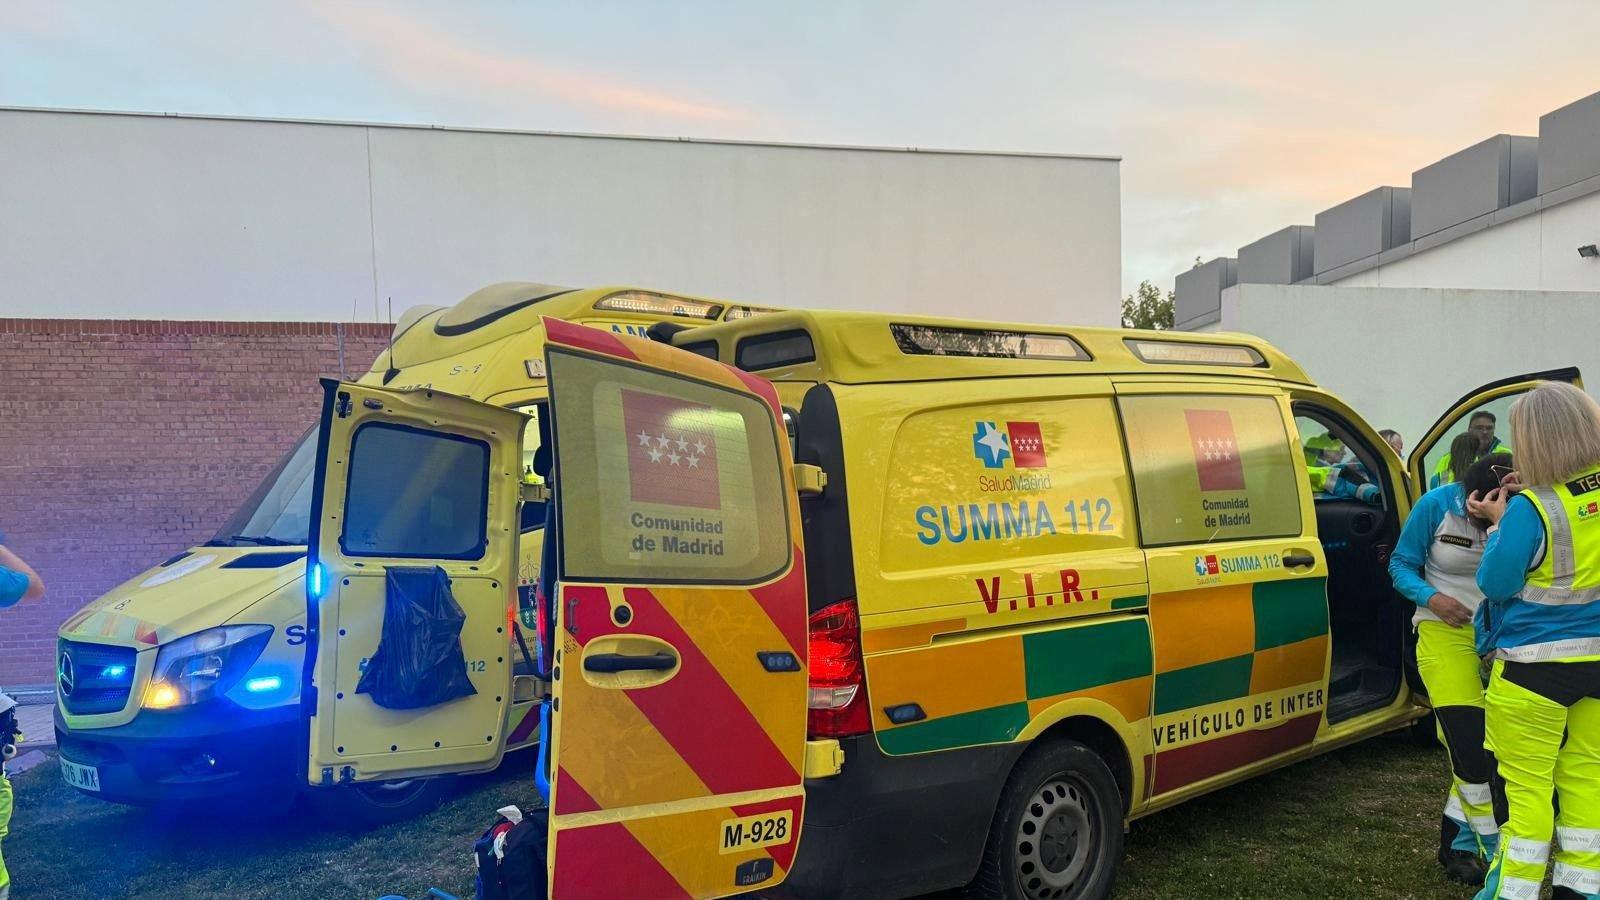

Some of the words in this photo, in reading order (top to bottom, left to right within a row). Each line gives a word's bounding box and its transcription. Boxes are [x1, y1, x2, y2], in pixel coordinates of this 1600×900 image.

[979, 475, 1052, 492] SaludMadrid
[1202, 498, 1249, 511] Comunidad
[631, 512, 723, 534] Comunidad
[915, 500, 1057, 545] SUMMA
[1064, 497, 1114, 534] 112
[1204, 515, 1217, 528] de
[1219, 513, 1251, 527] Madrid
[631, 534, 656, 552] de
[662, 535, 724, 556] Madrid
[1220, 555, 1262, 574] SUMMA
[1263, 553, 1280, 569] 112
[975, 568, 1099, 614] V.I.R.
[1153, 708, 1245, 746] VEHÍCULO
[1254, 701, 1273, 723] DE
[1280, 689, 1323, 715] INTER
[724, 816, 787, 848] M-928
